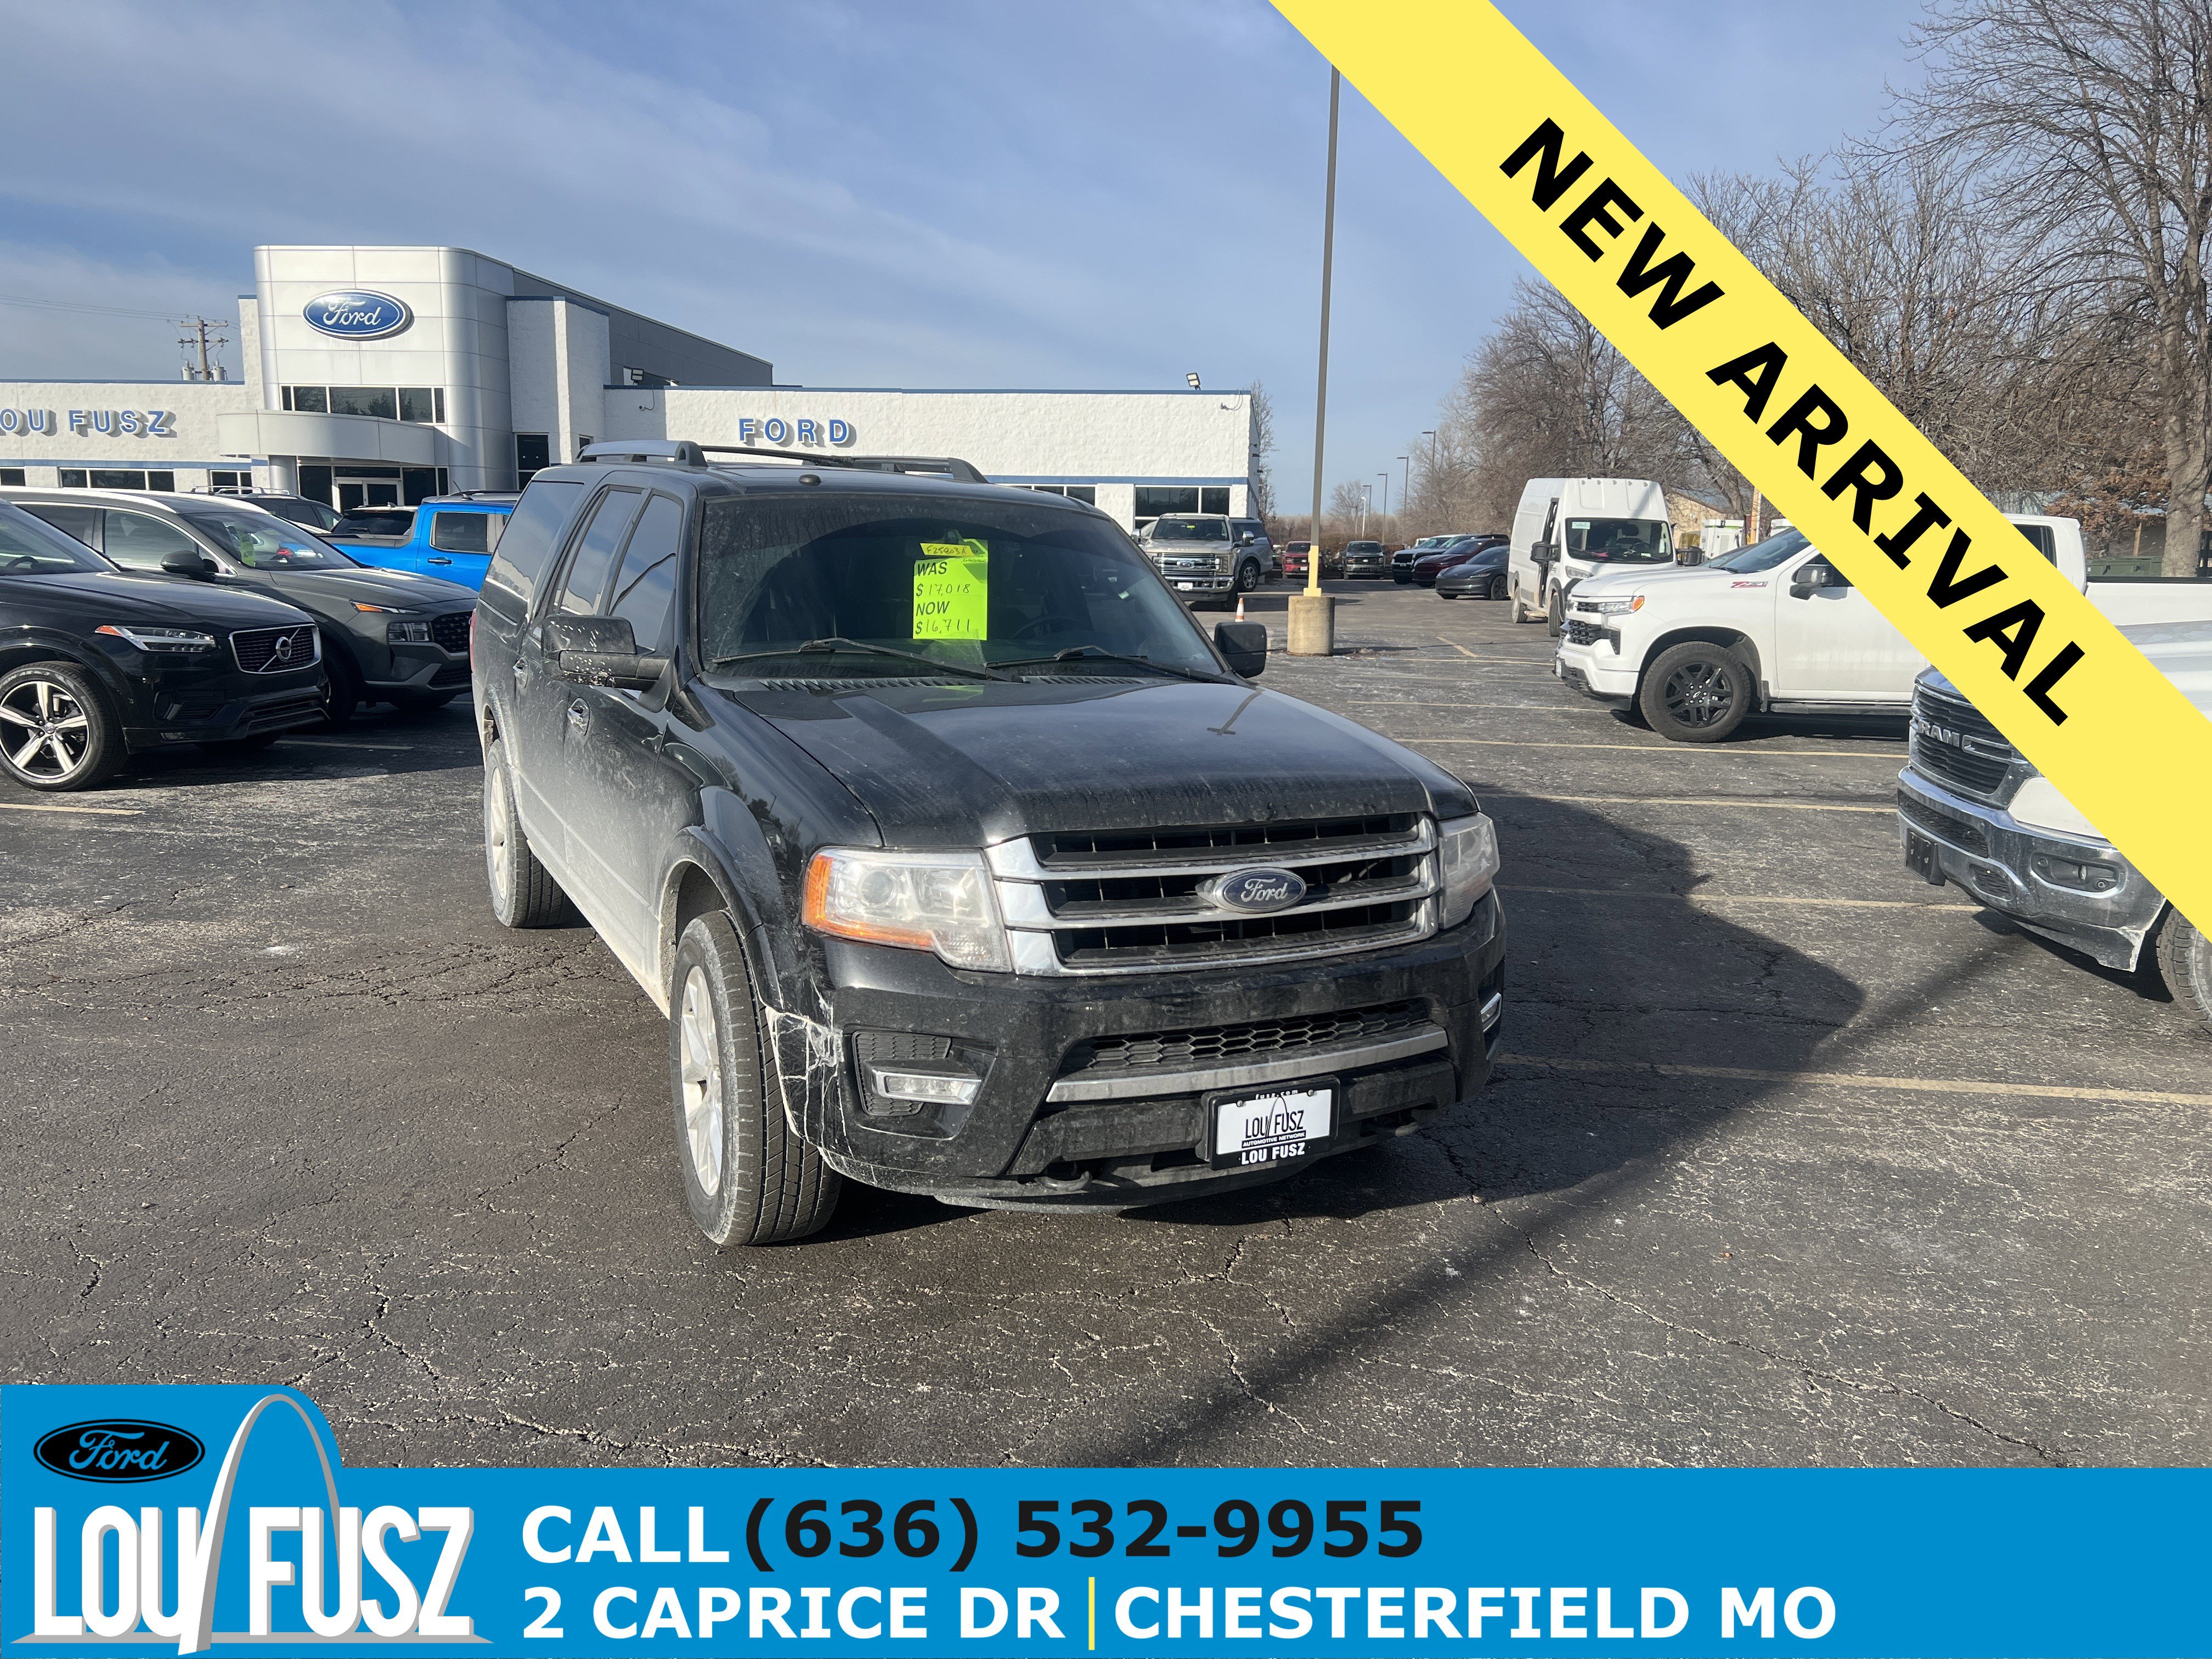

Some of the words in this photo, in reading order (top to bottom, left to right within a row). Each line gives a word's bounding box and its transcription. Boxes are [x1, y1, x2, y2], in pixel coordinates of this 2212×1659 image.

[323, 300, 382, 325] Ford
[69, 409, 168, 434] FUSZ
[738, 417, 850, 443] FORD
[917, 561, 947, 576] WAS
[916, 601, 950, 617] NOW
[1917, 719, 1960, 747] RAM
[1240, 878, 1288, 902] Ford
[1245, 1115, 1268, 1139] LOU
[1274, 1110, 1305, 1134] FUSZ
[1243, 1137, 1278, 1148] AUTOMOTIVE
[1279, 1132, 1305, 1141] NETWORK
[1242, 1148, 1267, 1165] LOU
[1272, 1142, 1305, 1160] FUSZ
